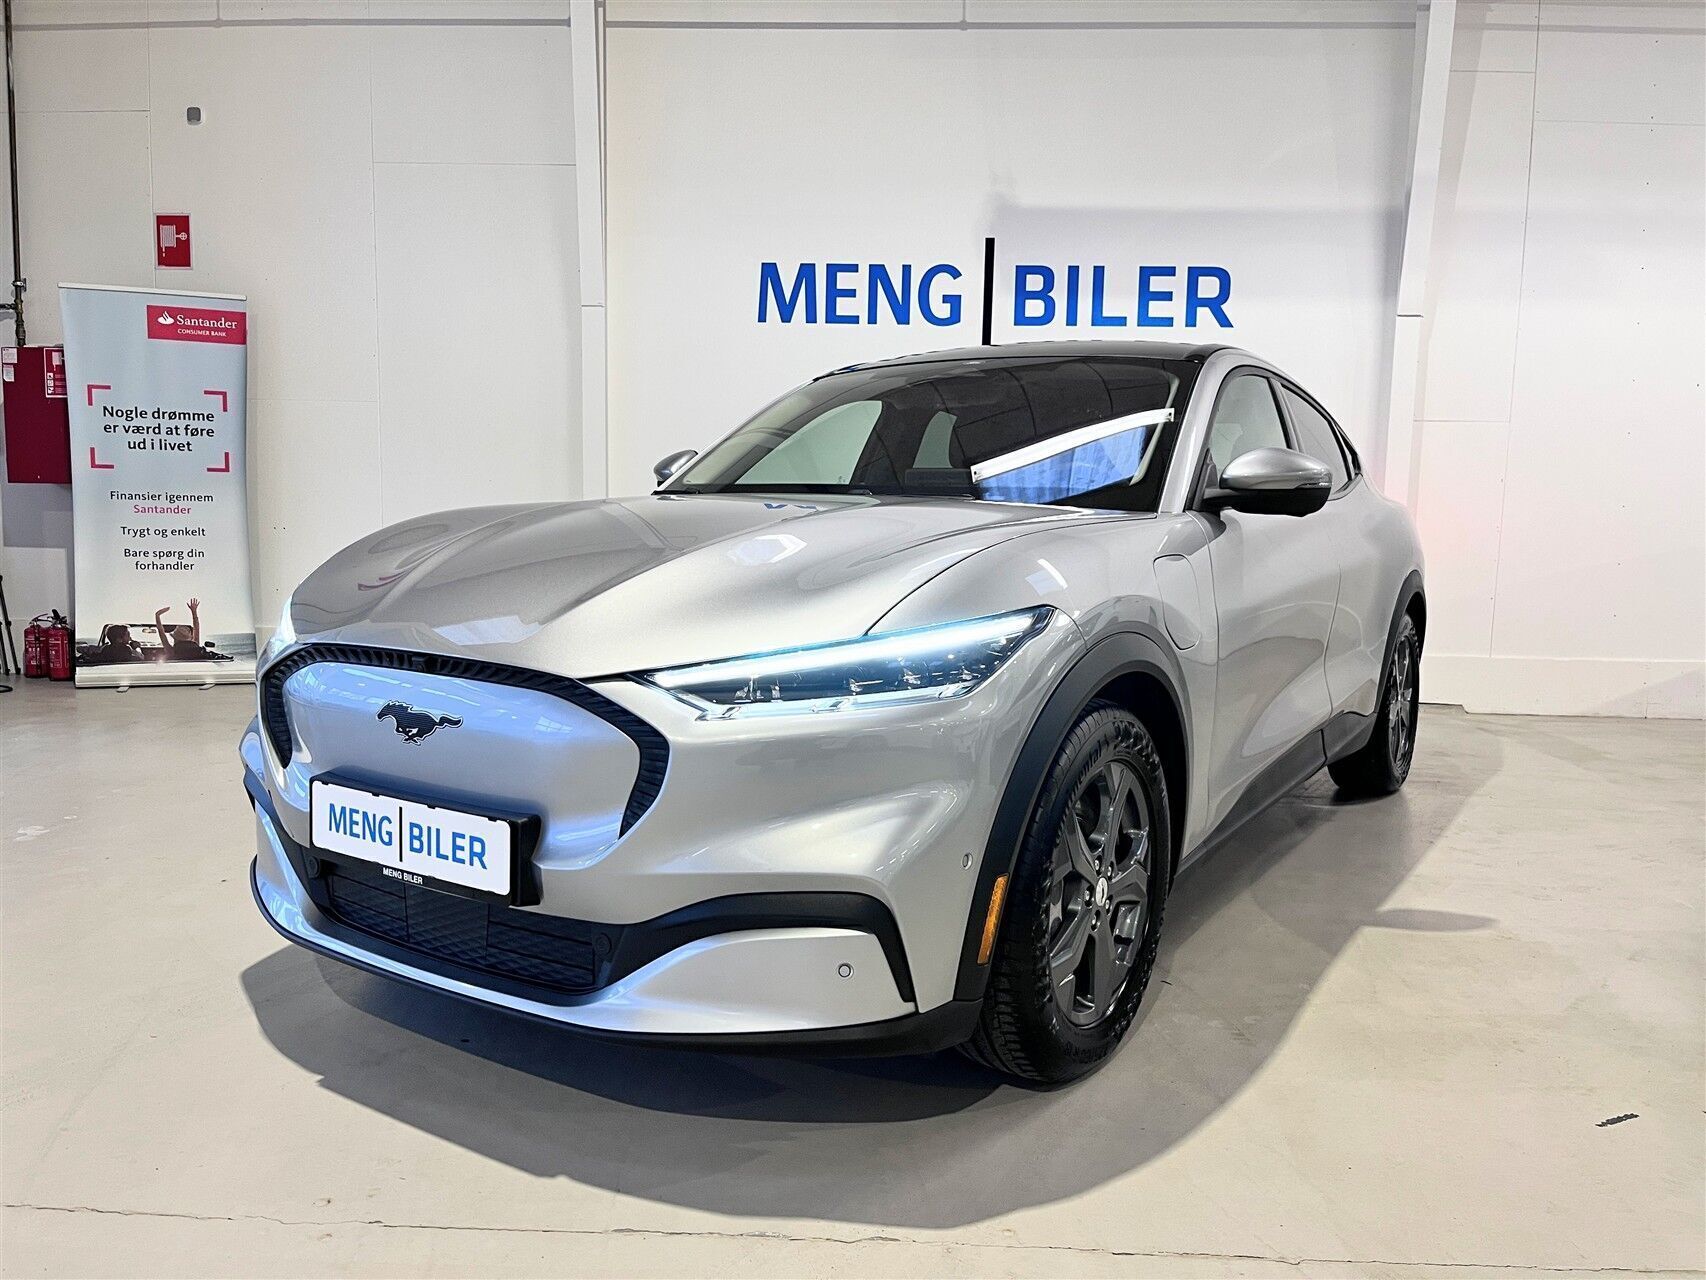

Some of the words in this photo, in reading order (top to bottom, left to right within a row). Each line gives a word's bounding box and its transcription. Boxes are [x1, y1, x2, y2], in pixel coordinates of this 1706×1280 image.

[757, 262, 963, 327] MENG
[1013, 264, 1234, 328] BILER
[176, 314, 238, 329] Santander
[177, 328, 210, 336] CONSUMER
[103, 405, 147, 422] Nogle
[152, 407, 214, 422] drømme
[103, 424, 119, 433] er
[122, 423, 161, 435] værd
[165, 425, 181, 436] at
[184, 424, 214, 437] føre
[127, 438, 147, 450] ud
[151, 439, 155, 450] i
[159, 439, 192, 452] livet
[110, 491, 162, 501] Finansier
[165, 492, 214, 504] igennem
[133, 505, 191, 515] Santander
[120, 526, 151, 538] Trygt
[154, 528, 168, 538] og
[171, 527, 206, 536] enkelt
[124, 548, 149, 558] Bare
[152, 549, 184, 560] spørg
[187, 549, 205, 558] din
[135, 561, 194, 570] forhandler
[328, 803, 393, 846] MENG
[409, 821, 487, 869] BILER
[382, 867, 402, 880] MENG
[403, 872, 423, 885] BILER
